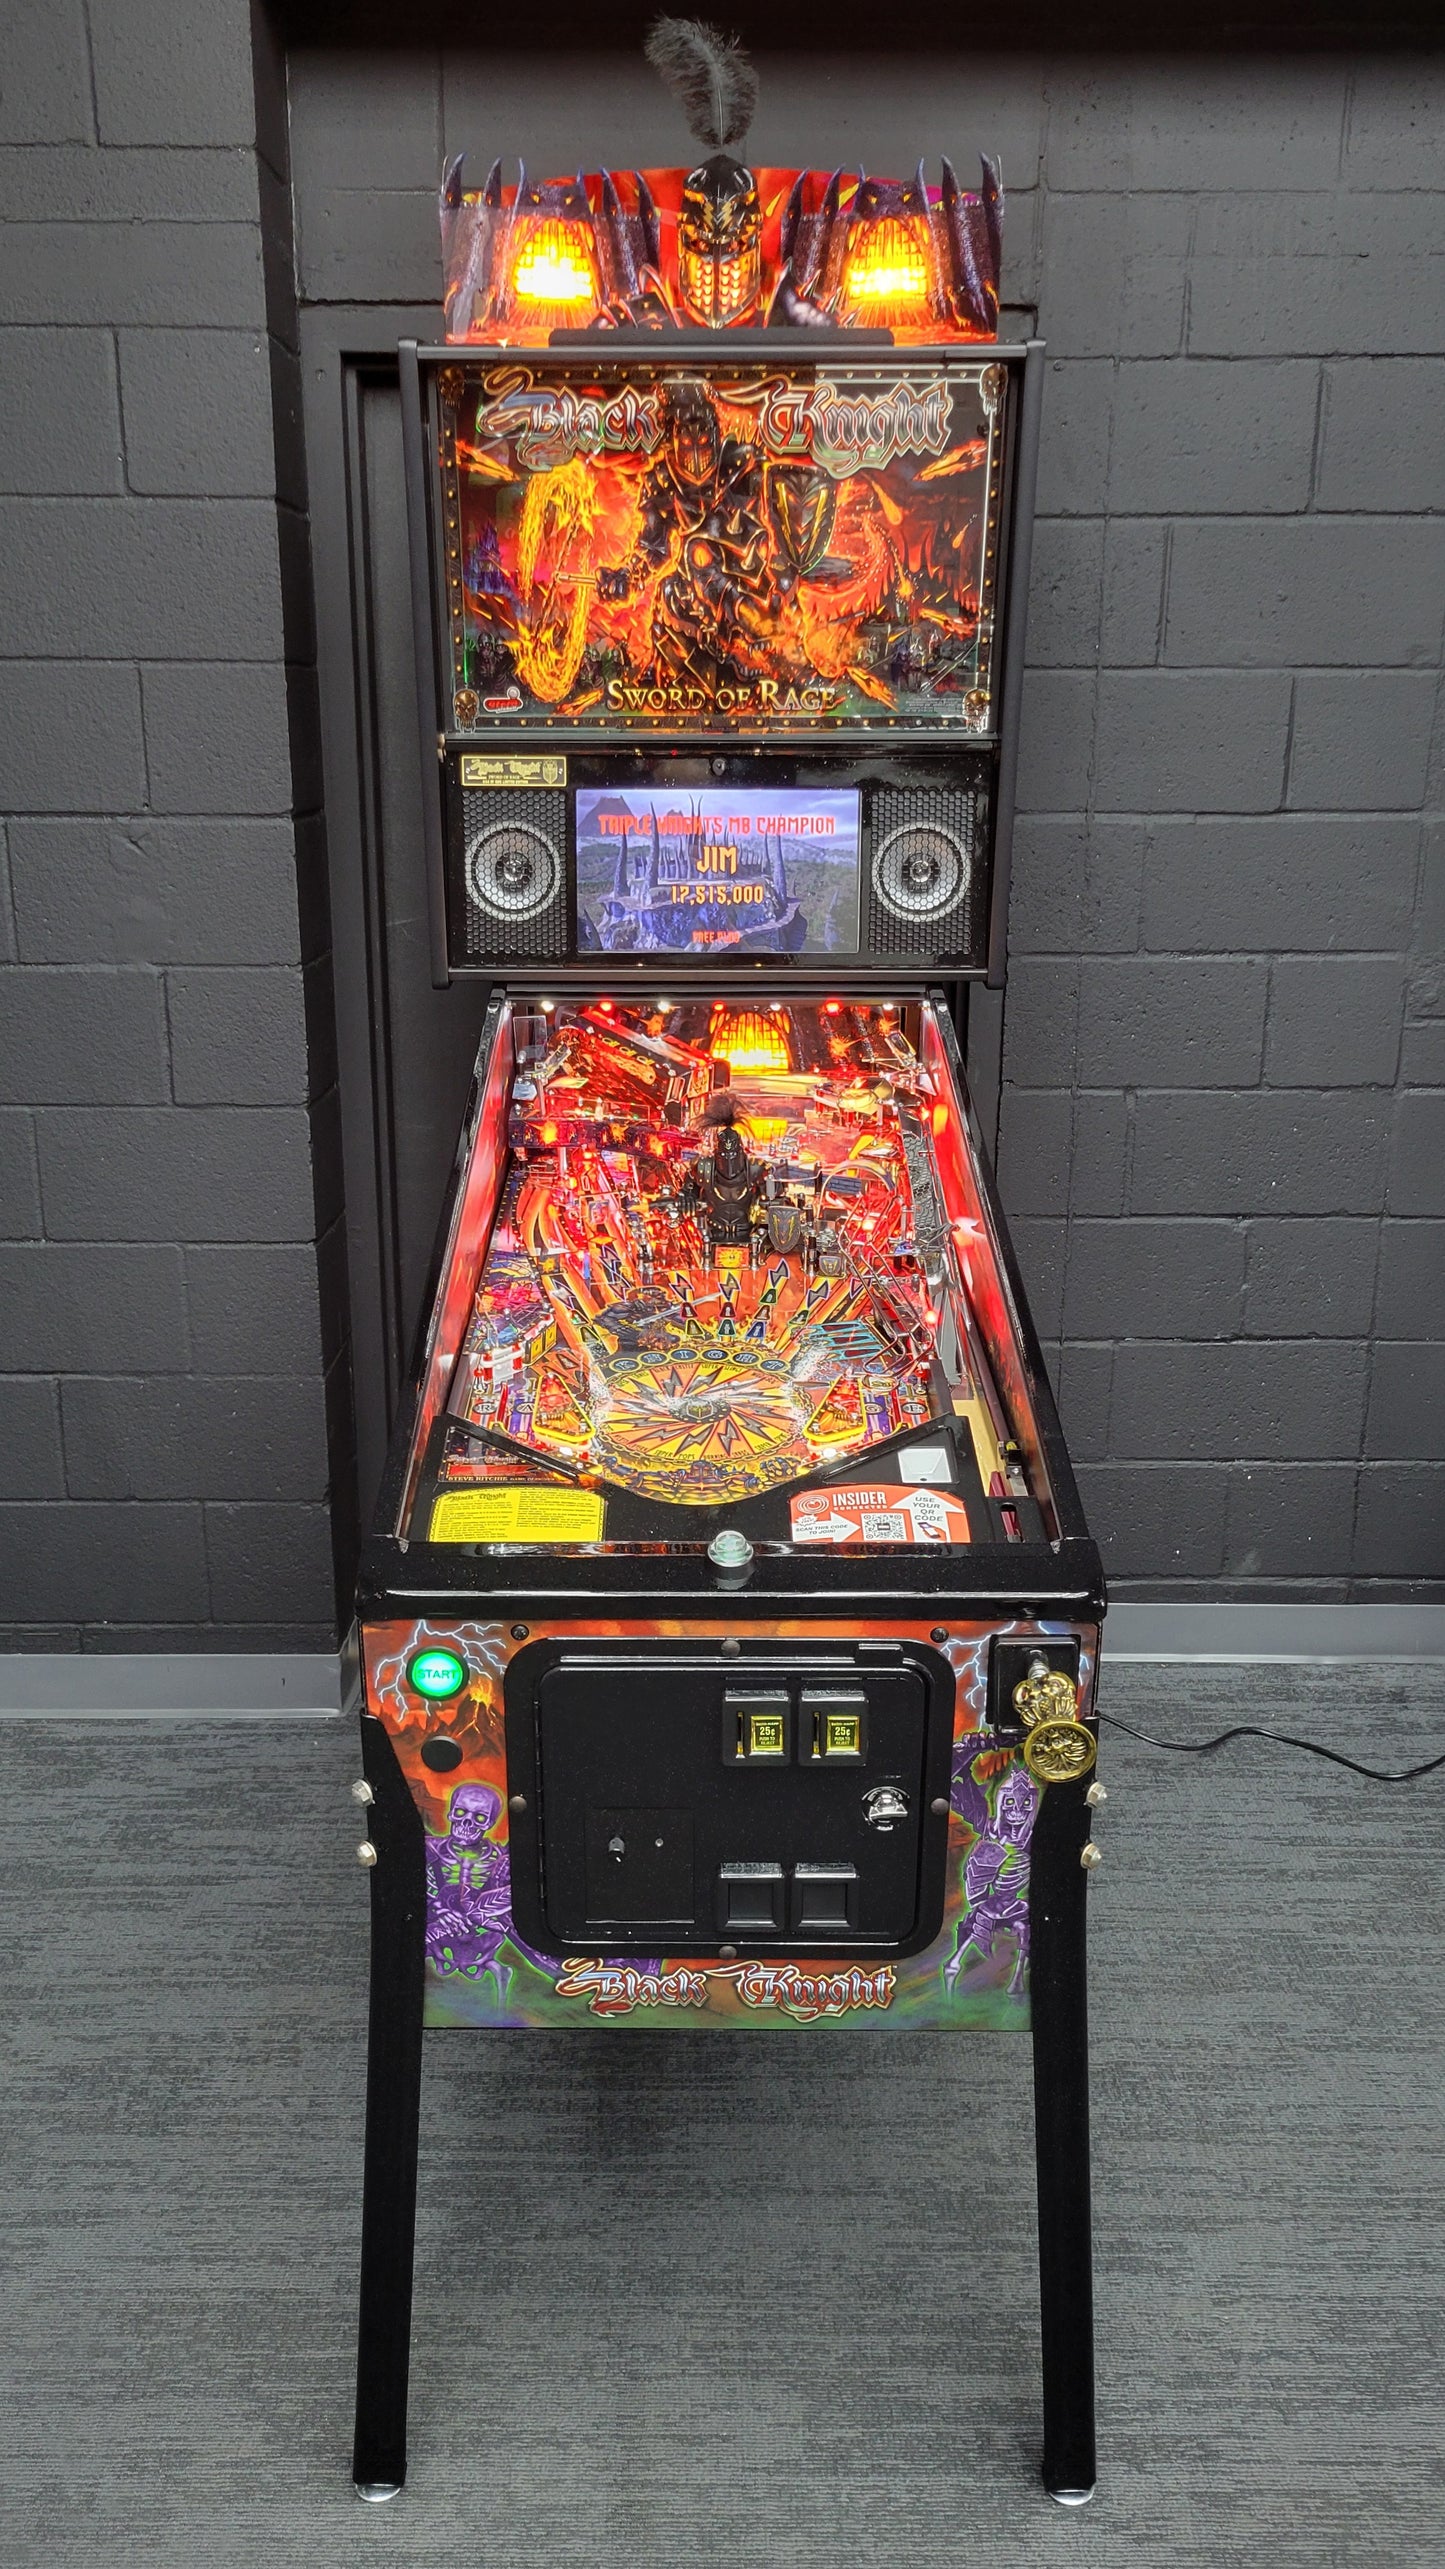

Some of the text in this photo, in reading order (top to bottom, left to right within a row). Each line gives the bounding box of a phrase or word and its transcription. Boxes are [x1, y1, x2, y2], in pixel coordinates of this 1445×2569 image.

[478, 366, 953, 479] Black Knight
[607, 680, 836, 711] SWORD OF RAGE
[598, 815, 834, 835] TRIPLE KNIGHTS MB CHAMPION
[696, 846, 738, 874] JIM
[672, 885, 764, 905] 17,515,000
[832, 1491, 887, 1507] INSIDER
[417, 1669, 459, 1679] START
[760, 1726, 776, 1736] 25¢
[835, 1726, 850, 1736] 25¢
[555, 1958, 896, 2023] Black Knight
